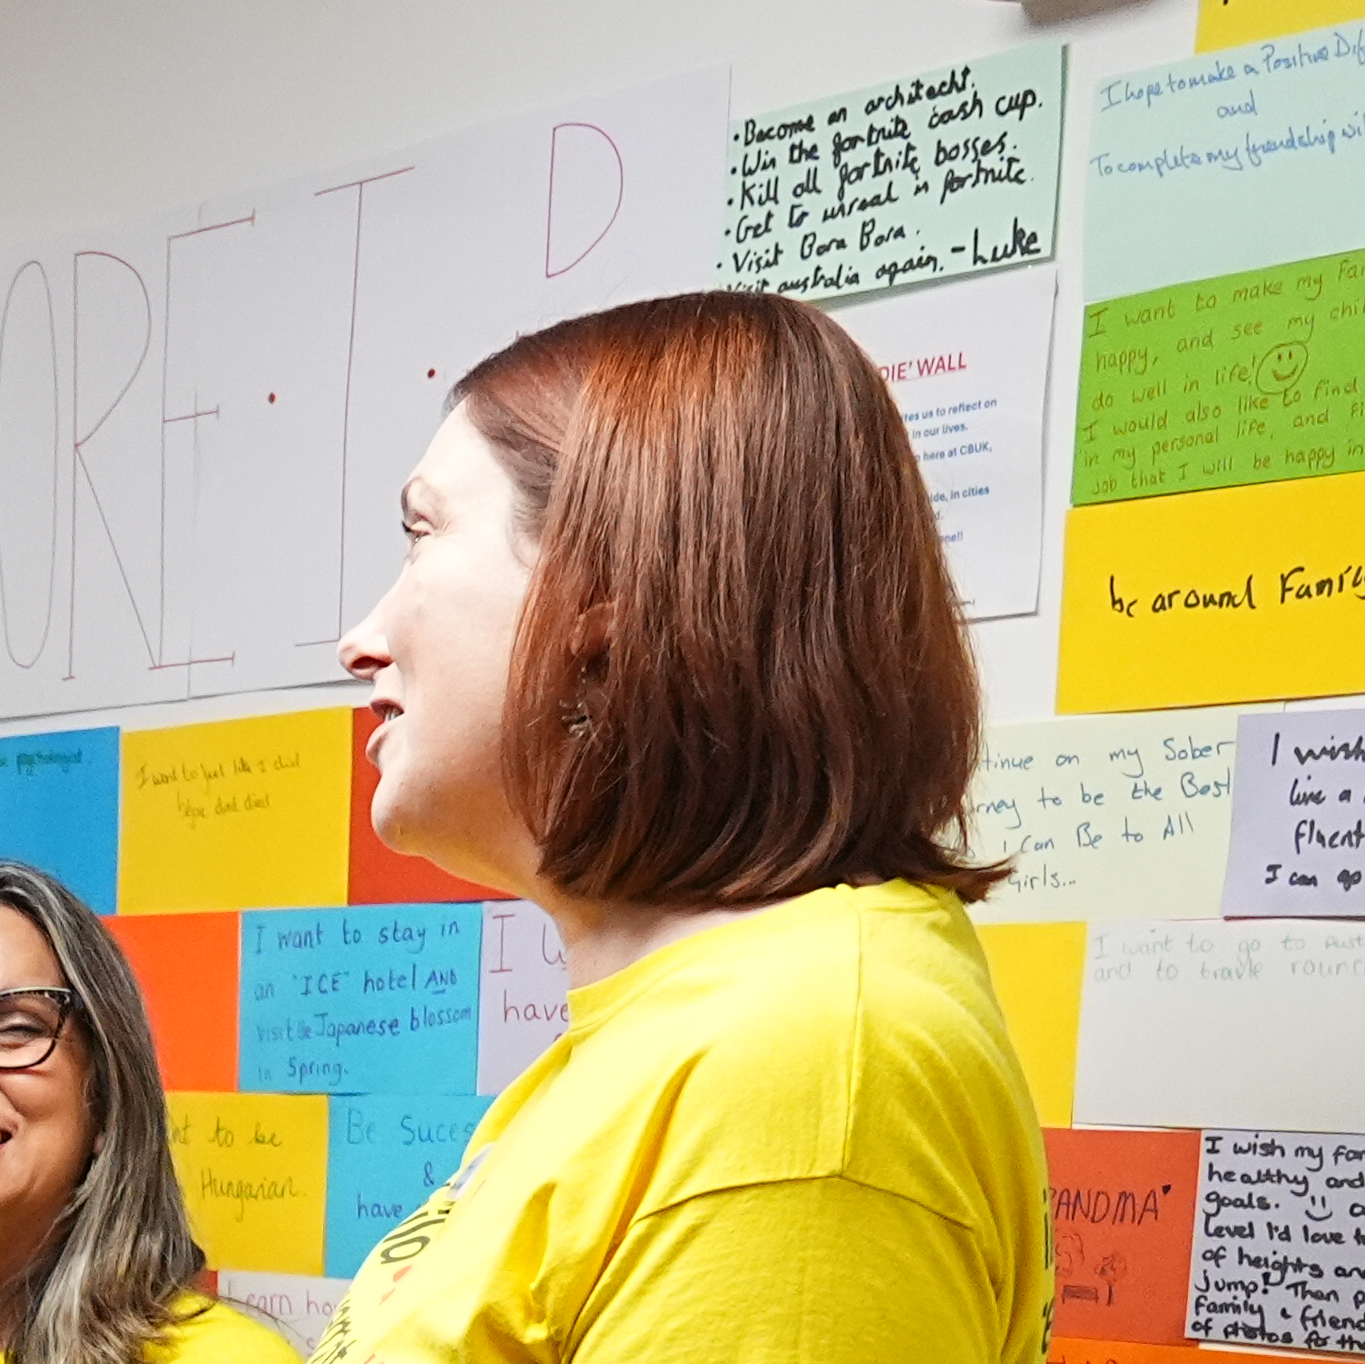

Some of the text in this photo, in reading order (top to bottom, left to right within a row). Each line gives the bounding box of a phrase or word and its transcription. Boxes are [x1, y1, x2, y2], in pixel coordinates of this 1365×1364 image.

[1217, 89, 1258, 118] and
[742, 149, 776, 176] Win
[788, 142, 819, 164] the
[928, 91, 983, 129] cash
[995, 88, 1043, 121] cup.
[744, 106, 847, 143] Become an
[740, 131, 1017, 211] Kill all bosses.
[736, 211, 774, 243] Get
[788, 205, 809, 228] to
[913, 176, 928, 197] in
[732, 242, 783, 273] Visit
[800, 232, 847, 260] Bora
[1088, 274, 1323, 338] I want to make my
[1177, 330, 1214, 352] and
[1231, 322, 1263, 340] see
[1287, 314, 1314, 344] my
[917, 352, 966, 376] WALL
[922, 398, 997, 419] us to reflect on
[1083, 378, 1358, 444] I would also like to find
[1091, 392, 1114, 411] do
[1132, 380, 1167, 403] well
[1183, 375, 1199, 393] in
[924, 427, 940, 437] our
[942, 422, 968, 435] lives.
[1084, 452, 1099, 467] in
[1113, 446, 1136, 470] my
[1152, 427, 1219, 465] personal
[1293, 409, 1329, 428] and
[923, 451, 946, 462] here
[947, 448, 958, 458] at
[1131, 472, 1166, 489] that
[1178, 462, 1189, 483] I
[1202, 457, 1234, 476] will
[1253, 452, 1271, 470] be
[1285, 446, 1335, 469] happy
[951, 485, 990, 499] in cities
[1151, 574, 1257, 613] around
[1055, 735, 1235, 778] on my Sober
[1038, 768, 1231, 809] to be the Best
[1077, 821, 1103, 849] Be
[1121, 816, 1144, 843] to
[1162, 812, 1194, 840] All
[1265, 864, 1362, 892] I can go
[255, 918, 460, 955] I want to stay in
[364, 962, 416, 994] hotel
[314, 1012, 401, 1047] Japanese
[347, 1108, 375, 1145] Be
[1205, 1133, 1324, 1172] I wish my
[1208, 1162, 1365, 1197] healthy and
[357, 1193, 403, 1219] have
[1202, 1191, 1279, 1216] goals.
[1302, 1225, 1345, 1243] love
[1202, 1245, 1227, 1268] of
[1191, 1318, 1213, 1337] of
